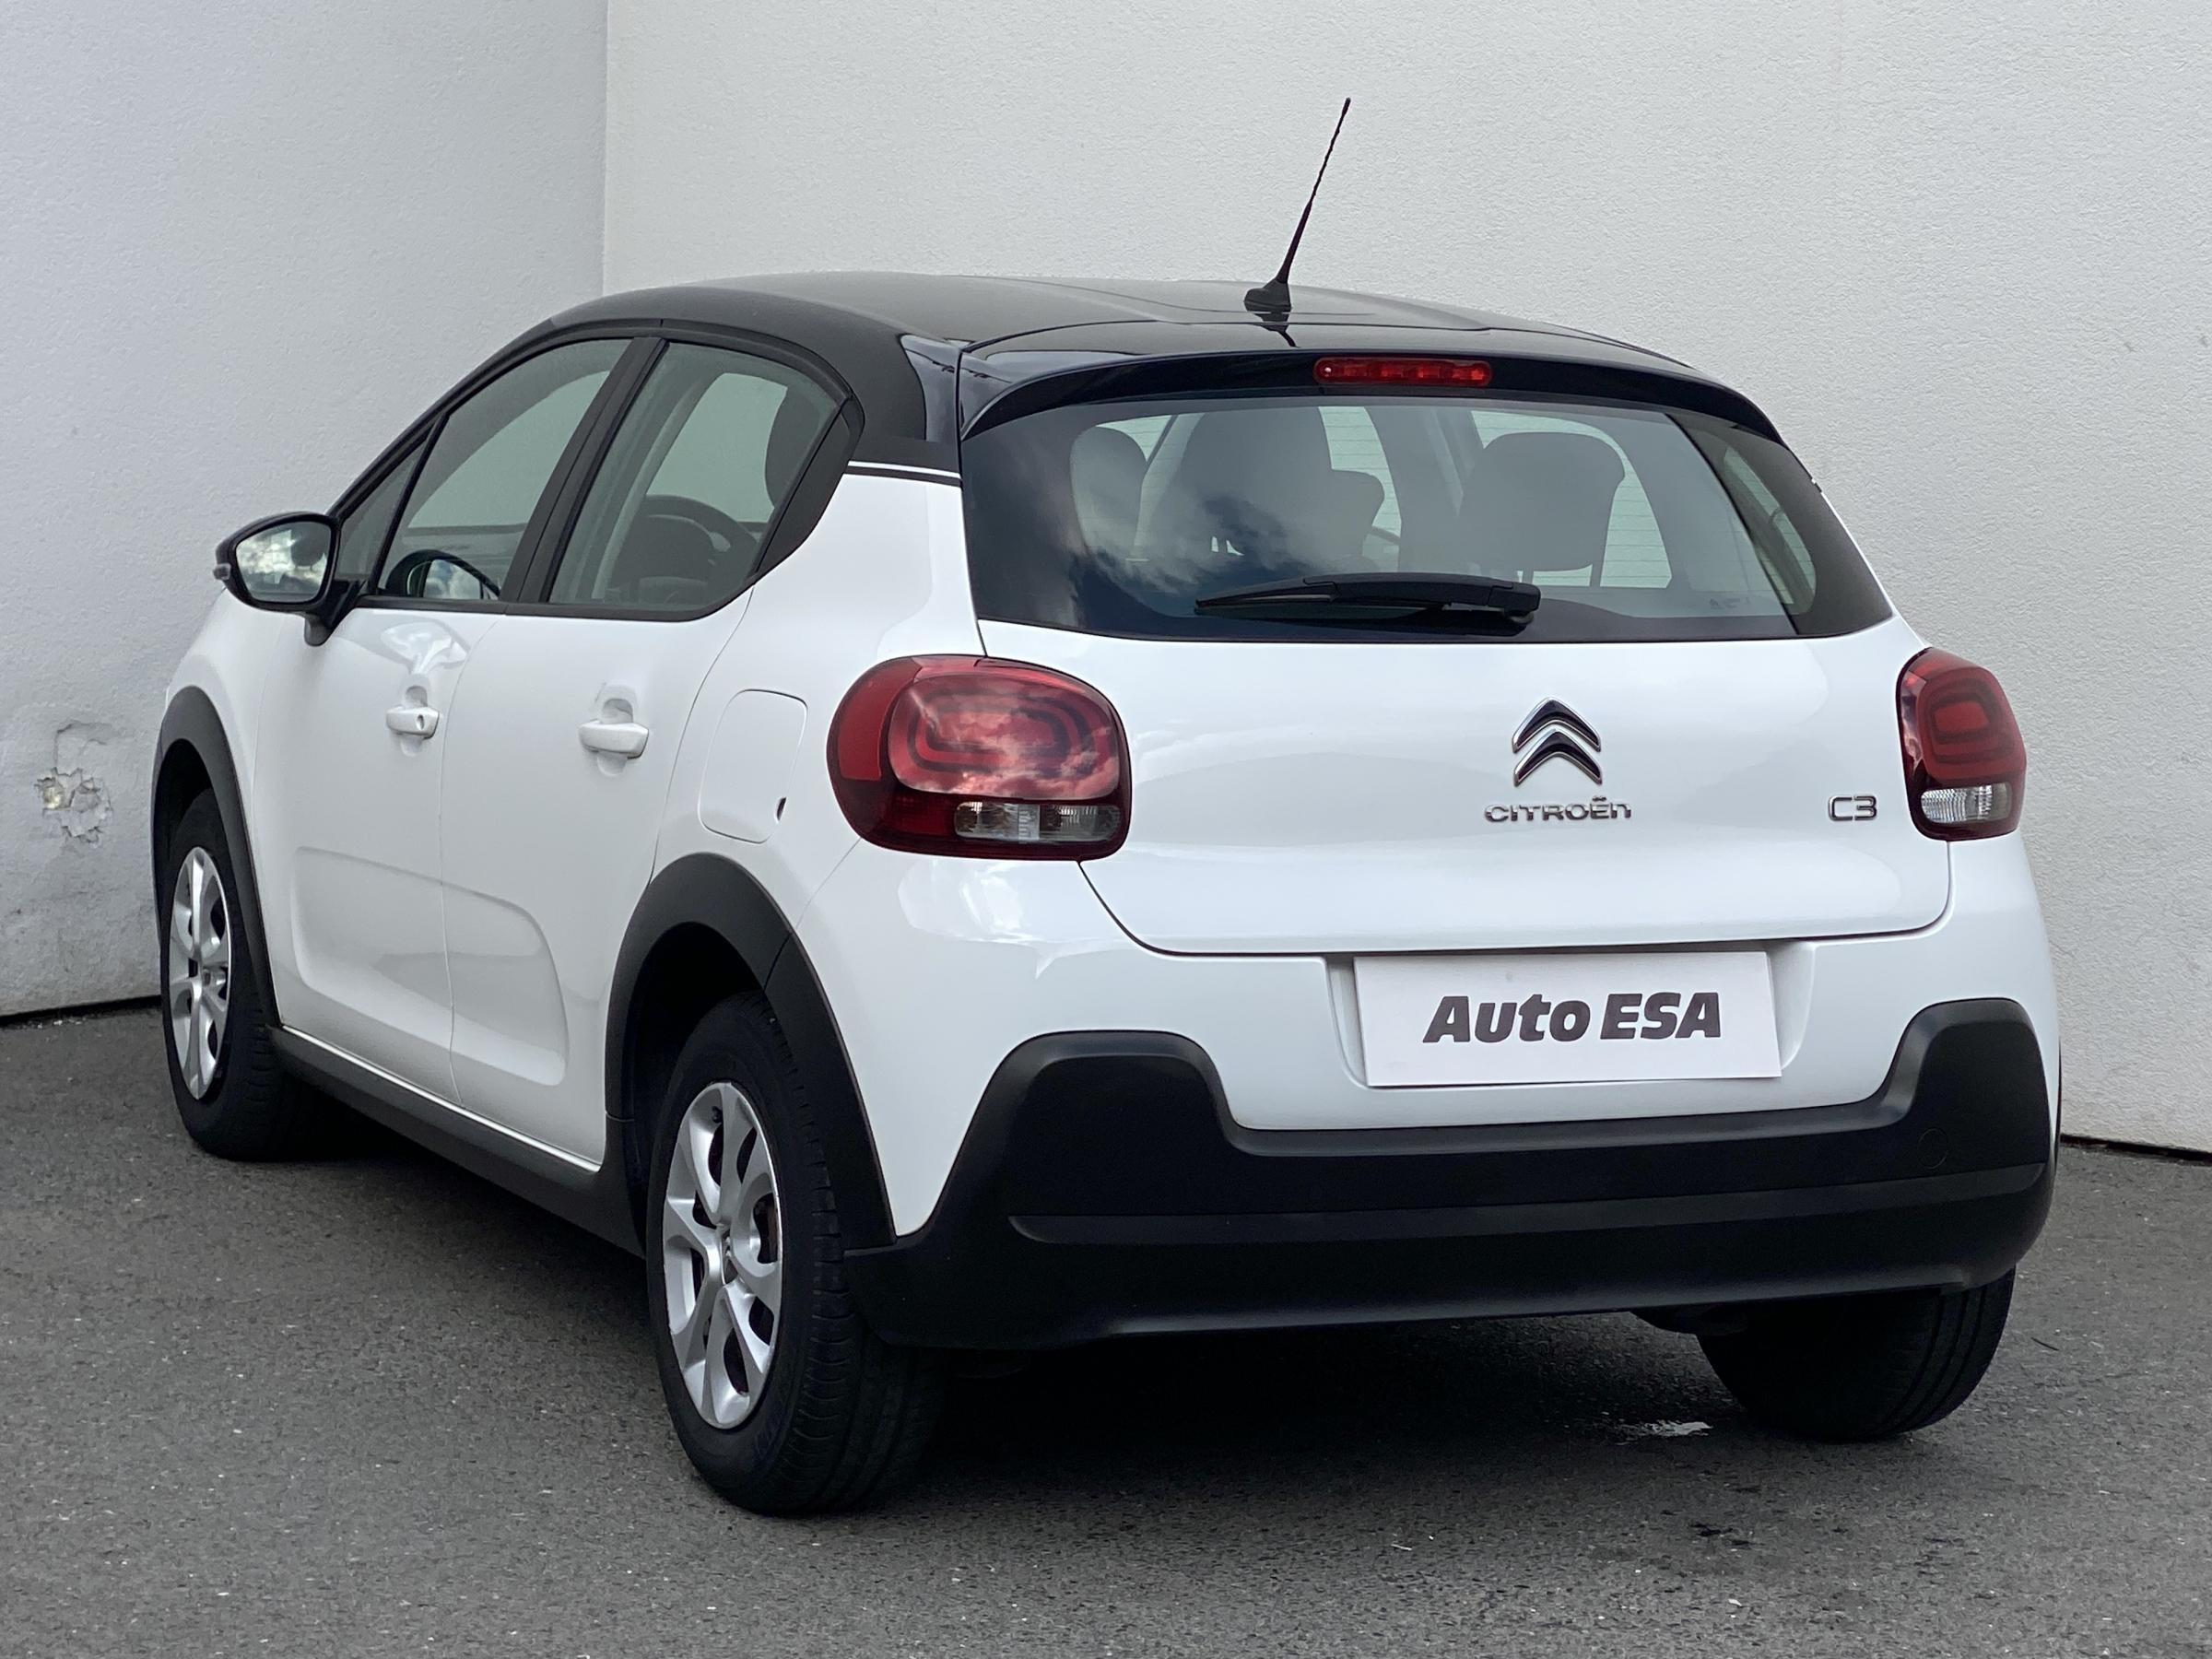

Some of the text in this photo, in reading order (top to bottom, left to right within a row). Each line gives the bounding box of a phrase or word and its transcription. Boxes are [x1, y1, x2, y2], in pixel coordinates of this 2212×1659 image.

[1828, 795, 1877, 821] C3
[1422, 992, 1721, 1042] Auto ESA
